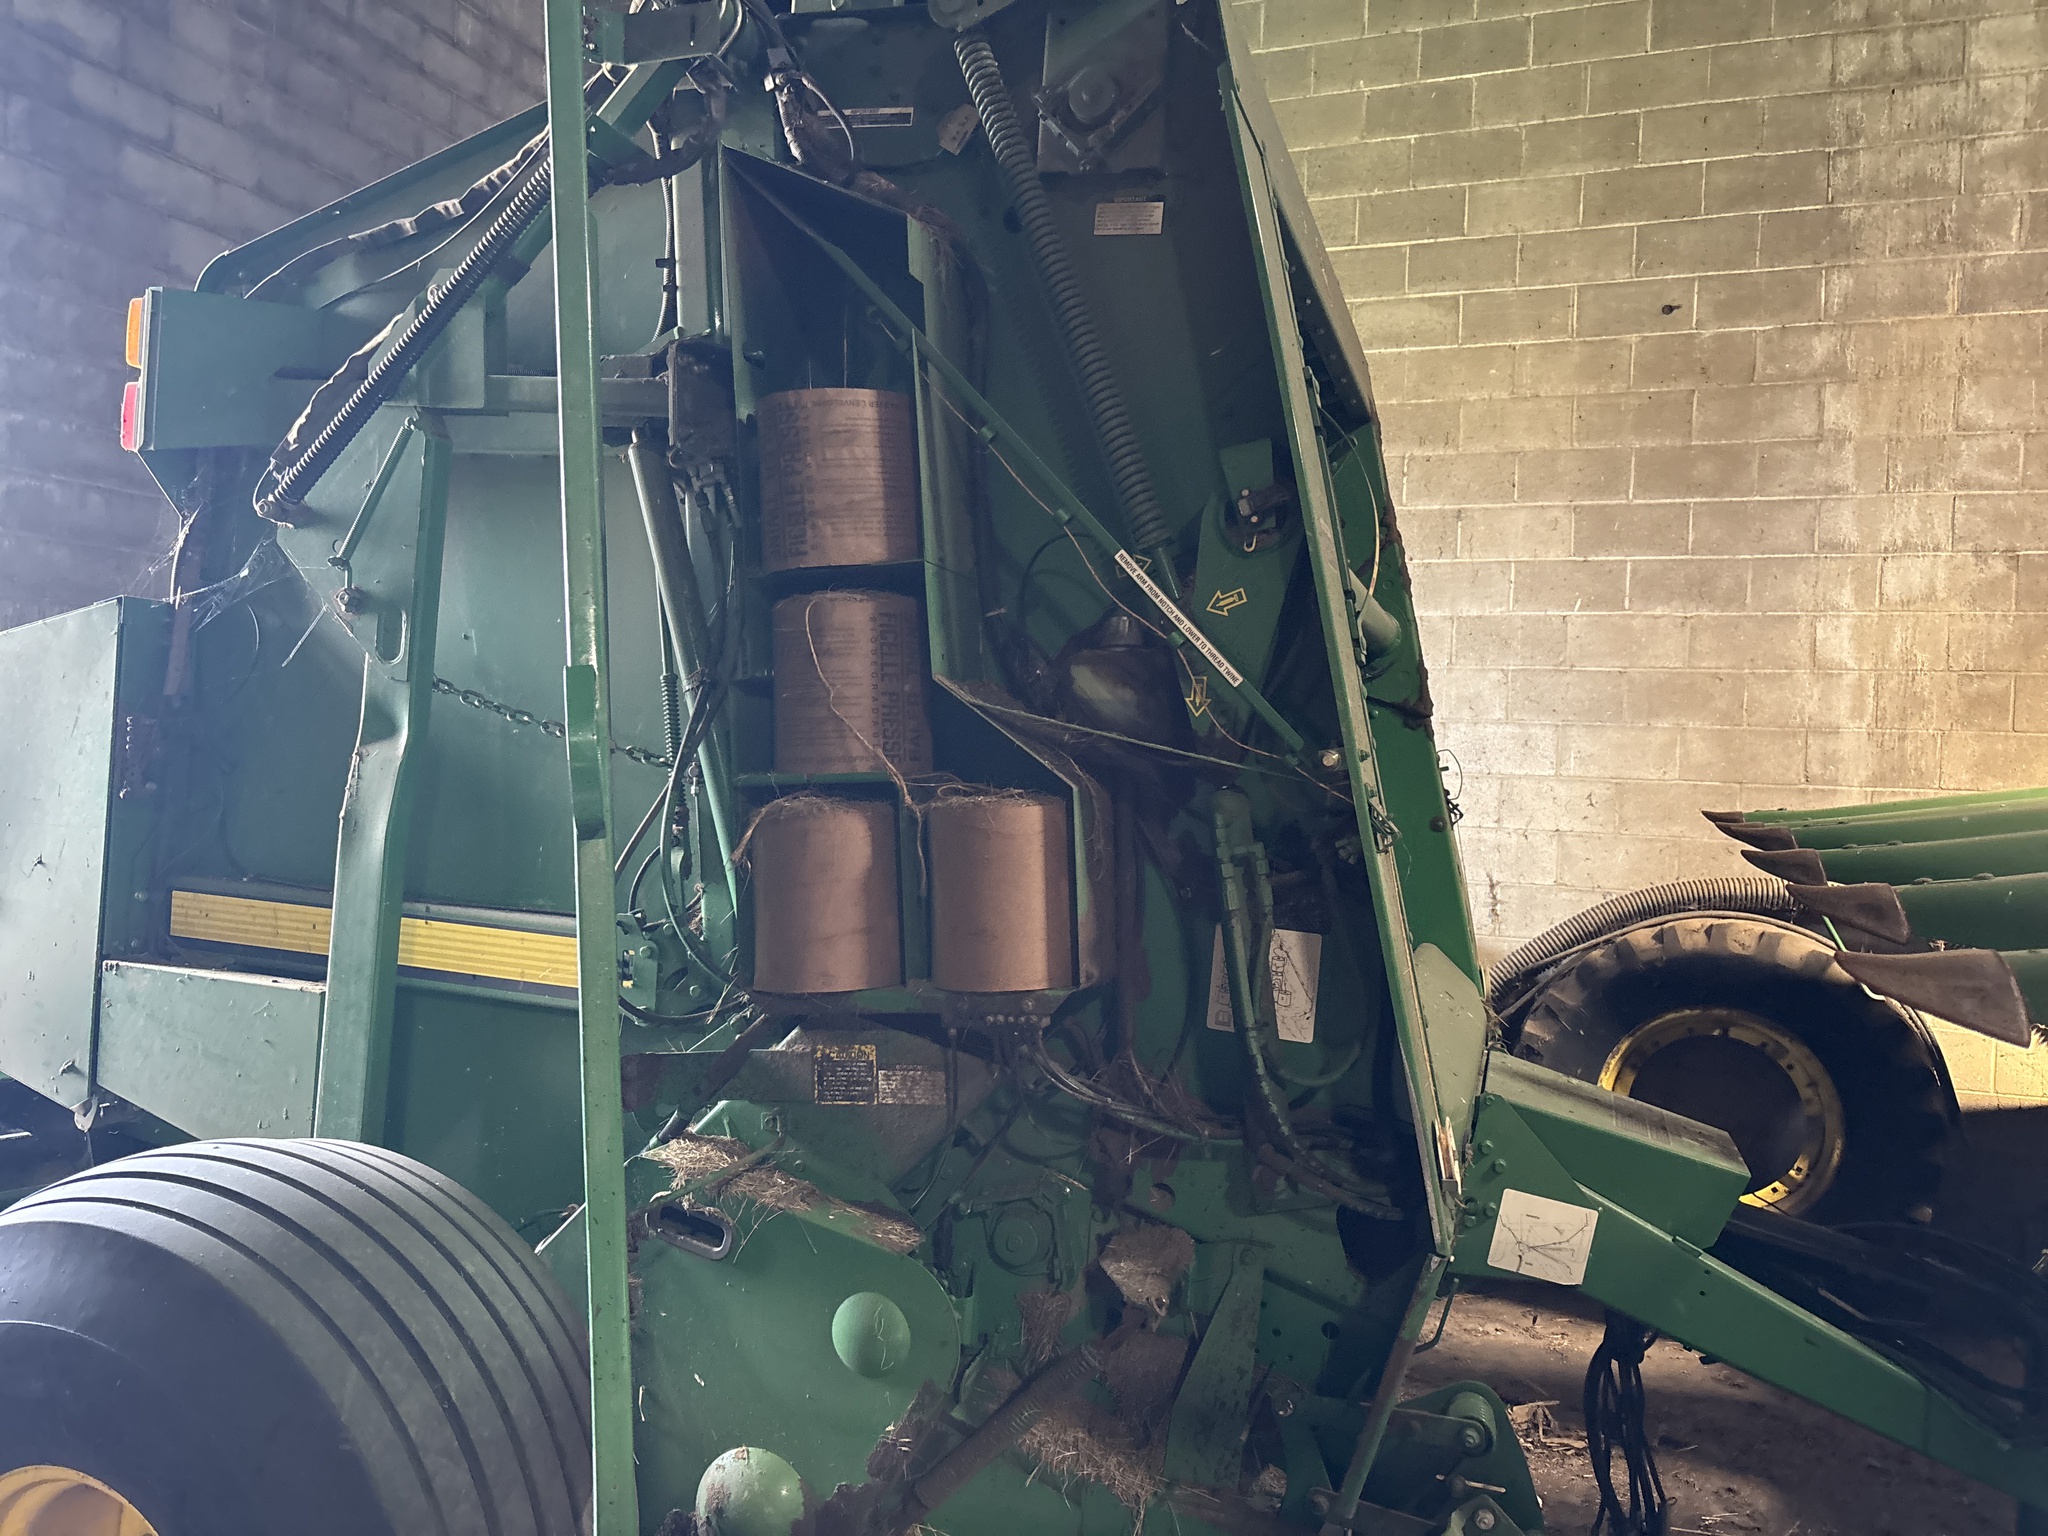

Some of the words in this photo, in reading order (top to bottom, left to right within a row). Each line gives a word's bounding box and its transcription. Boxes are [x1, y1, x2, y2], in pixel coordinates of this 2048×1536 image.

[878, 611, 900, 683] FICELLE
[1117, 552, 1137, 575] REMOVE
[1135, 572, 1148, 587] ARM
[1145, 582, 1161, 600] FROM
[1158, 596, 1176, 617] NOTCH
[1172, 613, 1185, 626] AND
[1182, 622, 1201, 644] LOWER
[1199, 640, 1207, 650] TO
[1205, 646, 1225, 669] THREAD
[1222, 664, 1240, 684] TWINE
[880, 690, 902, 764] PRESSE
